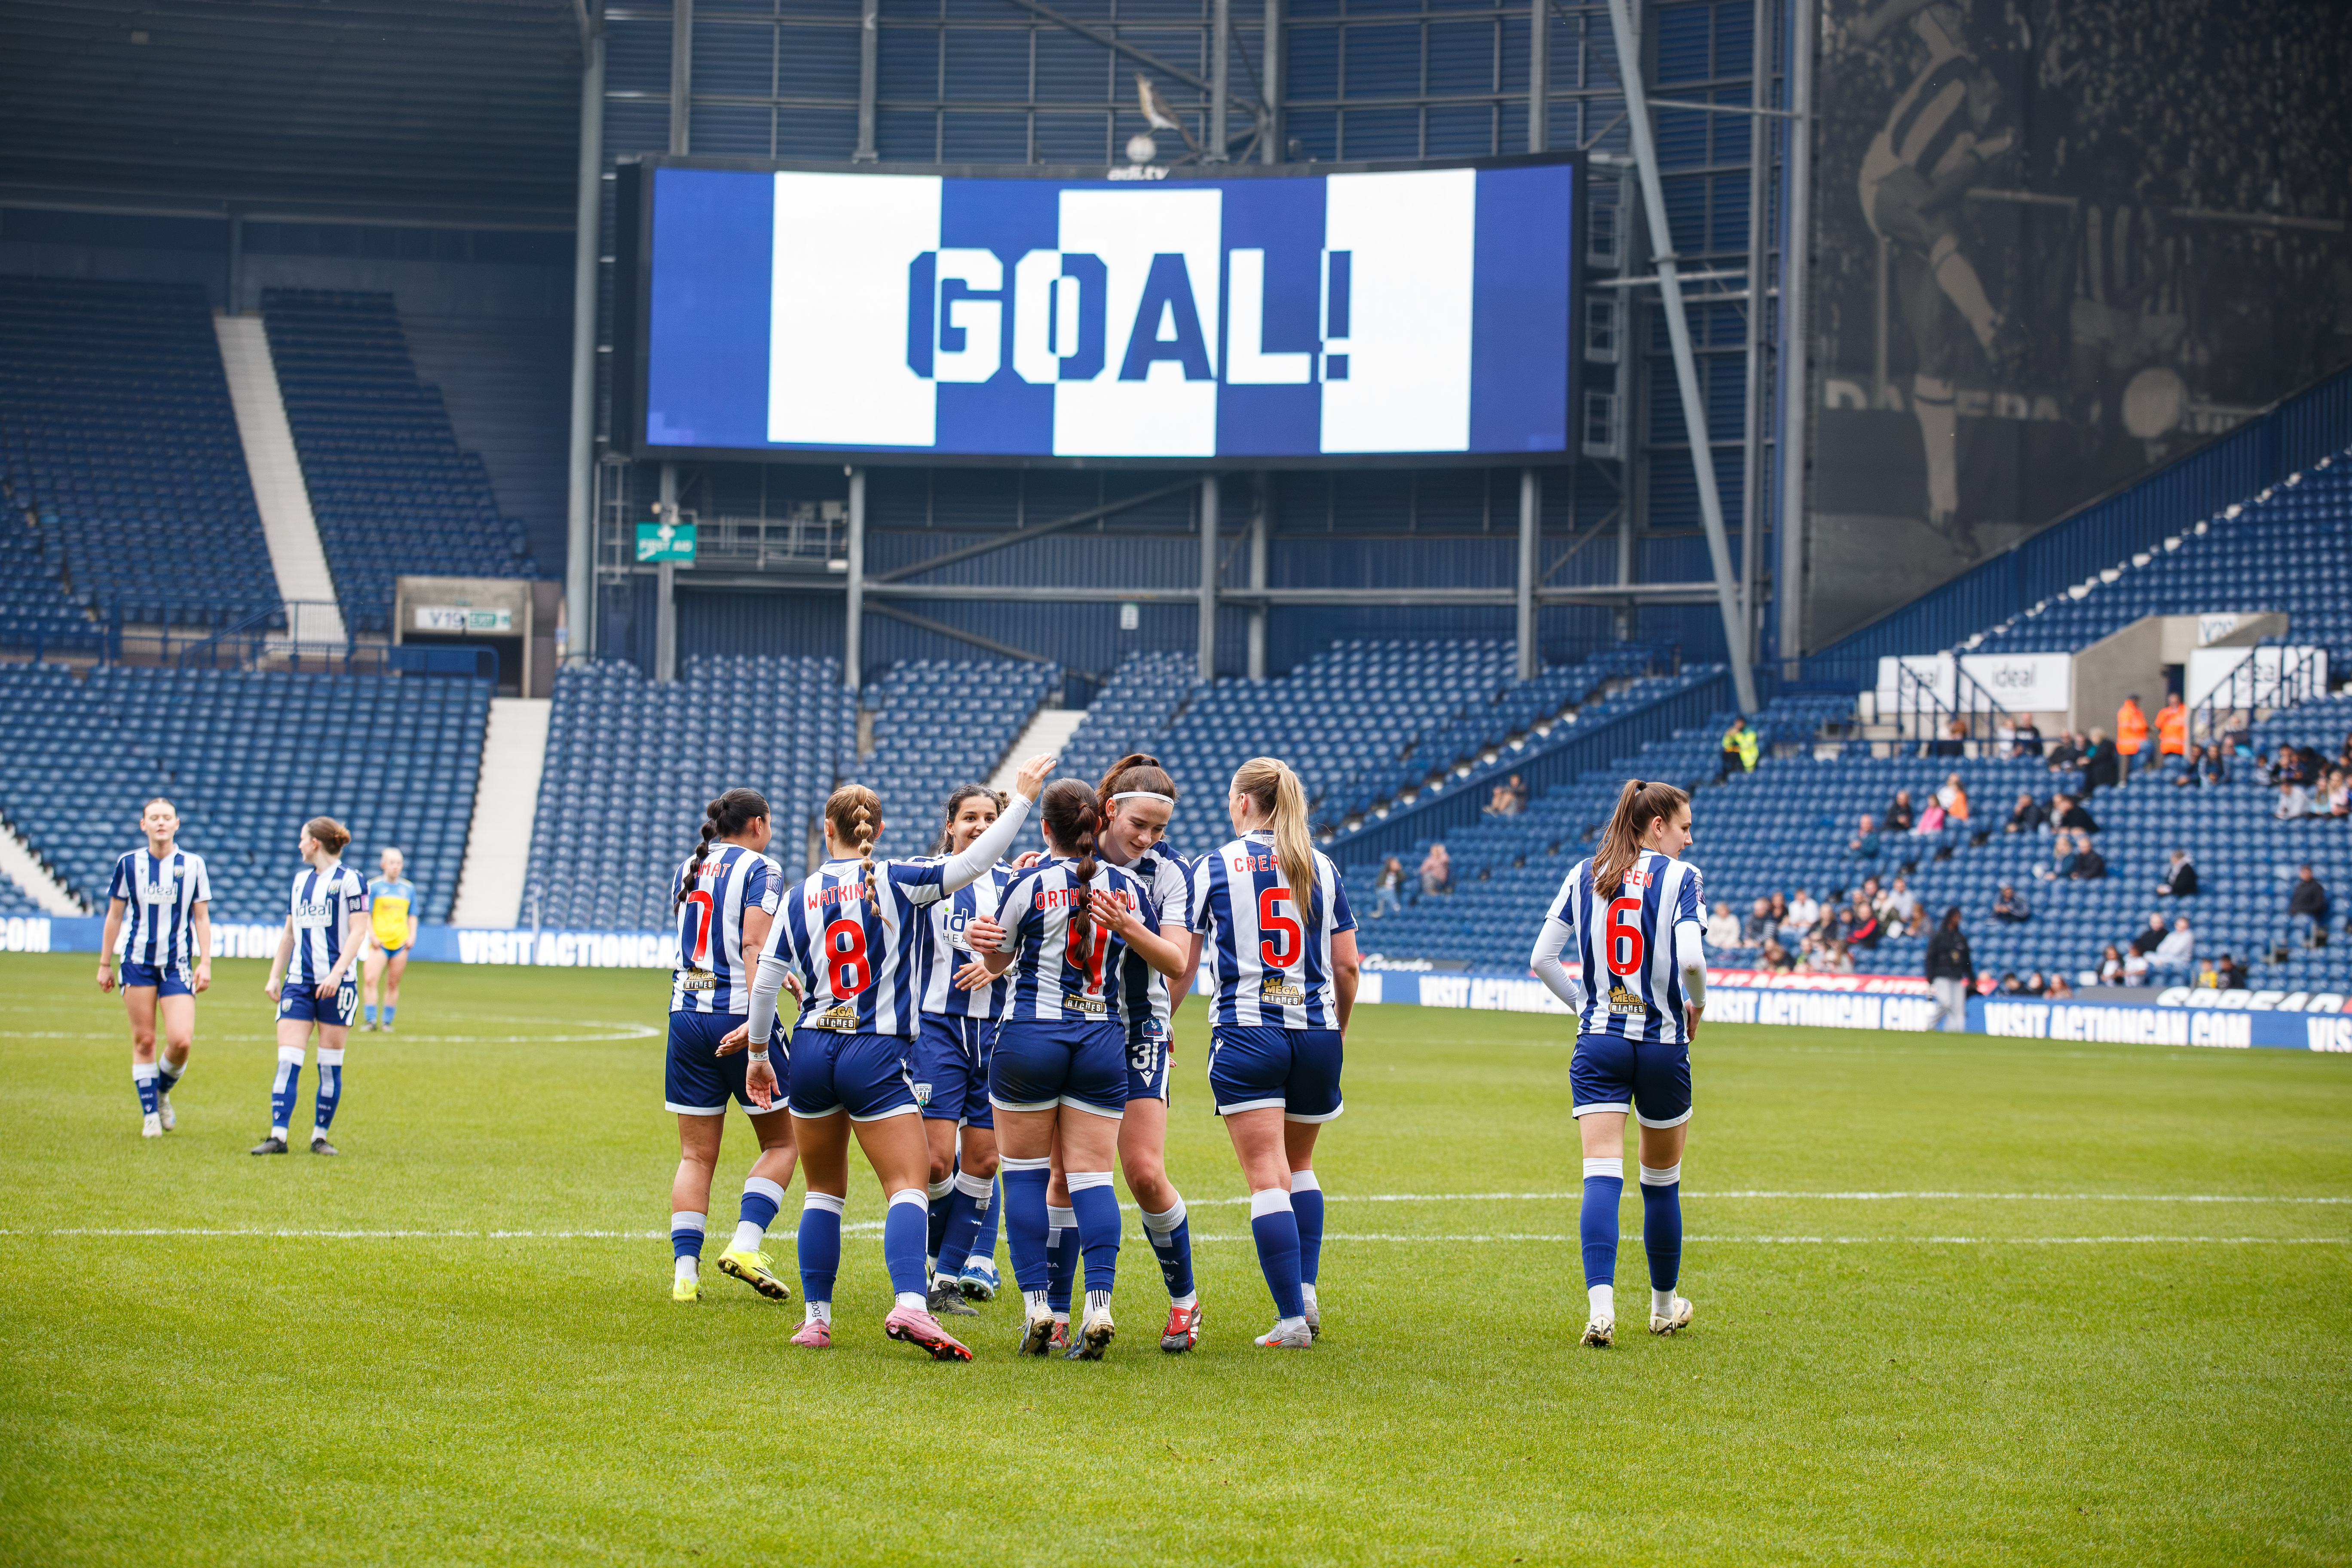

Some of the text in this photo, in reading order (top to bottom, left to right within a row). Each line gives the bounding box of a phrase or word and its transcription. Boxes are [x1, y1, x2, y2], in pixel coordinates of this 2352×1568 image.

[906, 248, 1353, 385] GOAL!
[688, 862, 731, 878] AMAT
[1234, 854, 1280, 872] CREA
[1623, 868, 1653, 888] EEN
[144, 881, 177, 895] ideal
[296, 899, 331, 918] ideal
[688, 890, 714, 962] 7
[1259, 887, 1302, 969] 5
[1605, 897, 1644, 976] 6
[457, 930, 678, 969] VISIT ACTIONCA
[825, 919, 872, 1001] 8
[686, 980, 713, 989] RICHES
[688, 971, 713, 980] MEGA
[337, 986, 354, 1011] 10
[1265, 985, 1298, 995] MEGA
[1419, 975, 1470, 1008] VISIT
[1612, 993, 1642, 1003] MEGA
[1067, 999, 1101, 1012] RICHES
[1264, 995, 1298, 1005] RICHES
[1611, 1004, 1643, 1013] RICHES
[819, 1017, 854, 1028] RICHES
[1983, 1002, 2049, 1039] VISIT
[1132, 1042, 1159, 1071] 31
